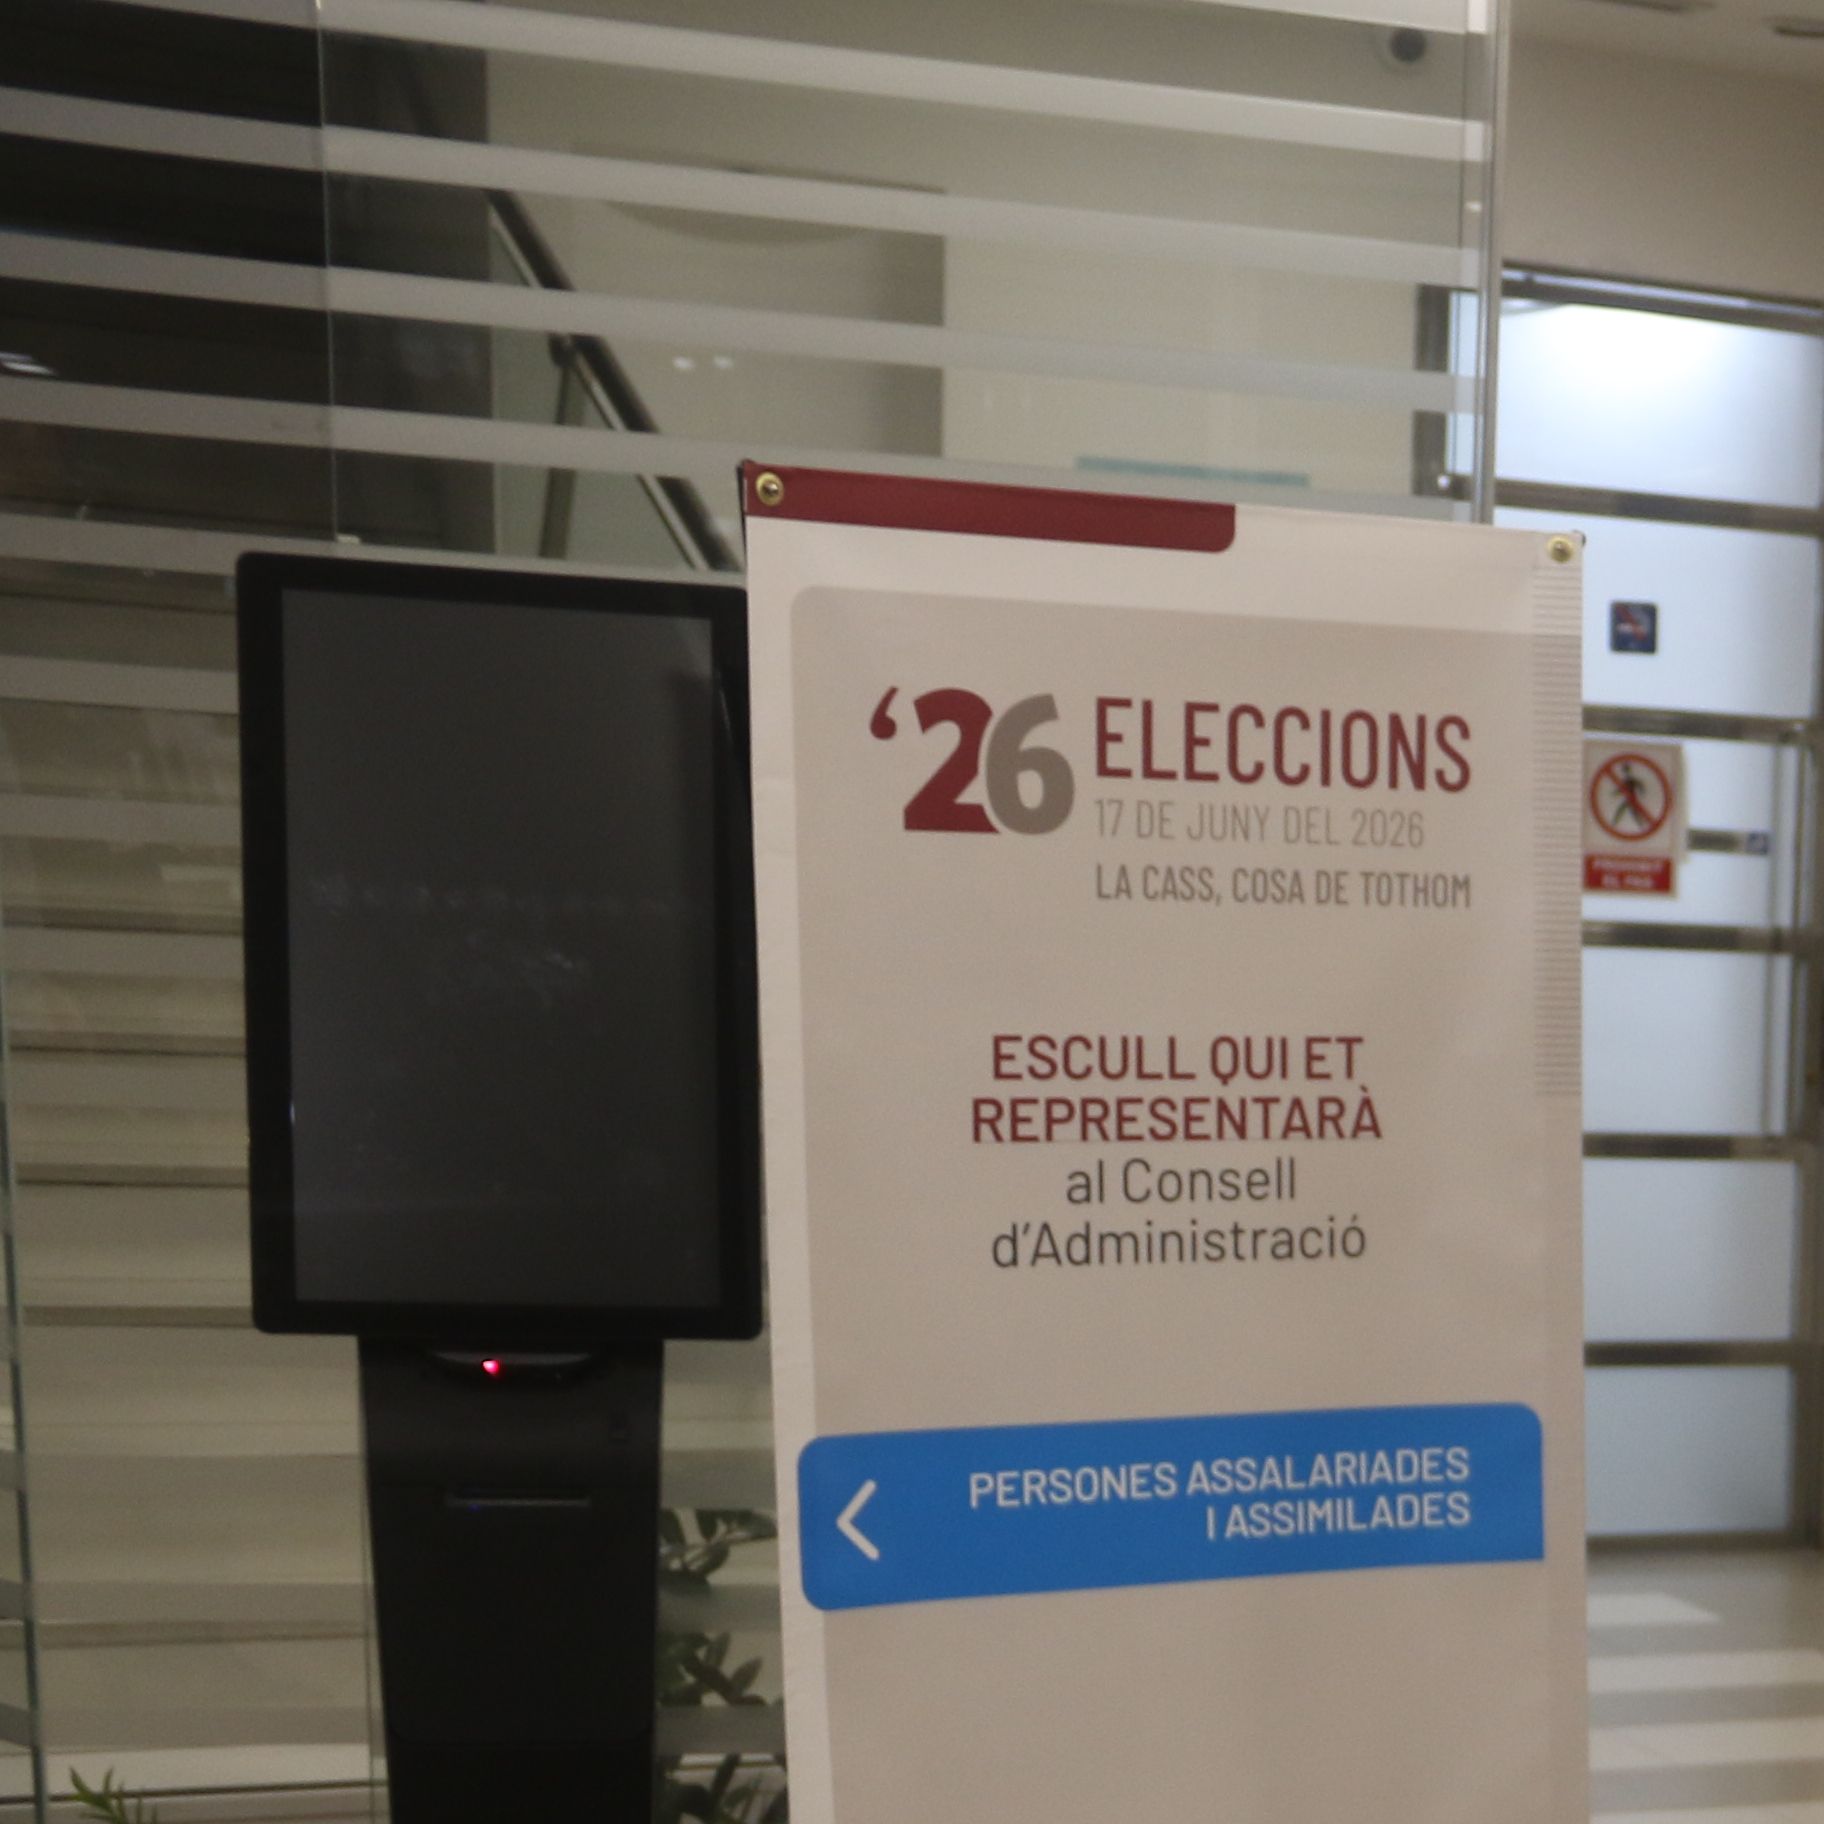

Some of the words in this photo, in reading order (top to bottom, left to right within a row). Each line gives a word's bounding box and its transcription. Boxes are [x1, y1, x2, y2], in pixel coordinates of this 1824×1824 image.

[1094, 695, 1473, 794] ELECCIONS
[1094, 798, 1124, 839] 17
[1135, 799, 1175, 841] DE
[1187, 800, 1271, 845] JUNY
[1282, 804, 1341, 848] DEL
[1350, 806, 1425, 850] 2026
[1095, 864, 1133, 902] LA
[1140, 865, 1223, 908] CASS,
[1231, 867, 1305, 905] COSA
[1314, 869, 1350, 906] DE
[1359, 871, 1472, 910] TOTHOM
[991, 1036, 1196, 1082] ESCULL
[1209, 1036, 1289, 1087] QUI
[1303, 1037, 1366, 1081] ET
[971, 1085, 1384, 1144] REPRESENTARÀ
[1065, 1159, 1106, 1204] al
[1120, 1157, 1297, 1205] Consell
[990, 1215, 1368, 1268] d'Administració
[969, 1462, 1178, 1509] PERSONES
[1186, 1446, 1471, 1494] ASSALARIADES
[1224, 1491, 1471, 1540] ASSIMILADES
